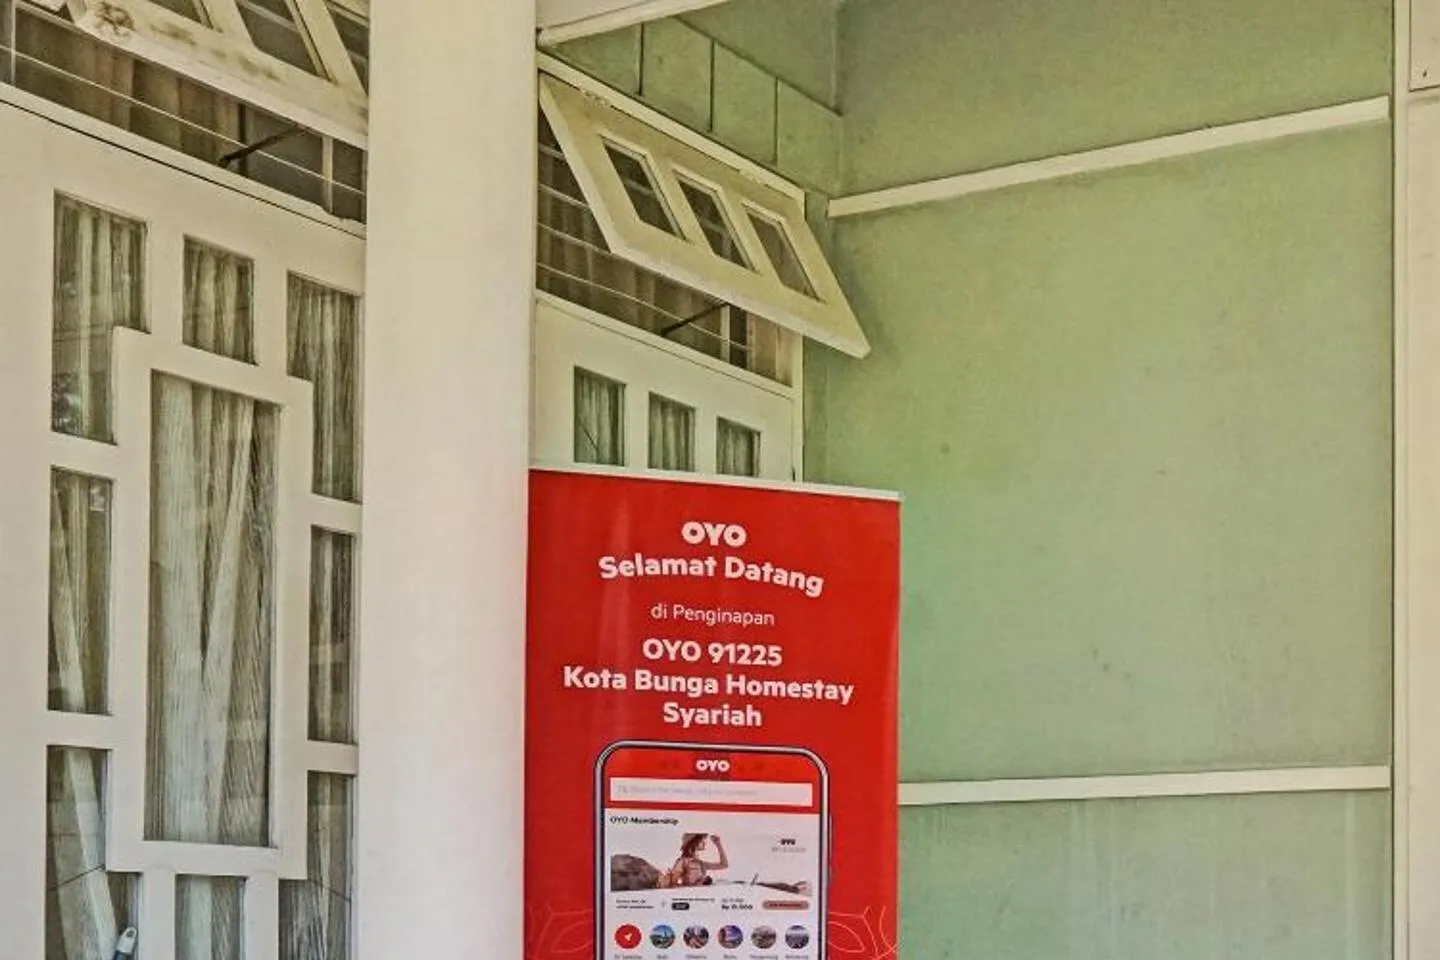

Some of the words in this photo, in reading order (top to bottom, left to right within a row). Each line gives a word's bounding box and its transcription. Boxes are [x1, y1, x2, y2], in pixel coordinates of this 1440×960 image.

[681, 521, 748, 547] OYO
[599, 552, 717, 581] Selamat
[724, 556, 824, 598] Datang
[651, 602, 668, 620] di
[673, 604, 775, 628] Penginapan
[642, 638, 701, 662] OYO
[708, 643, 783, 667] 91225
[564, 666, 627, 691] Kota
[634, 669, 719, 698] Bunga
[726, 675, 854, 706] Homestay
[663, 701, 763, 729] Syariah
[696, 759, 730, 772] OYO
